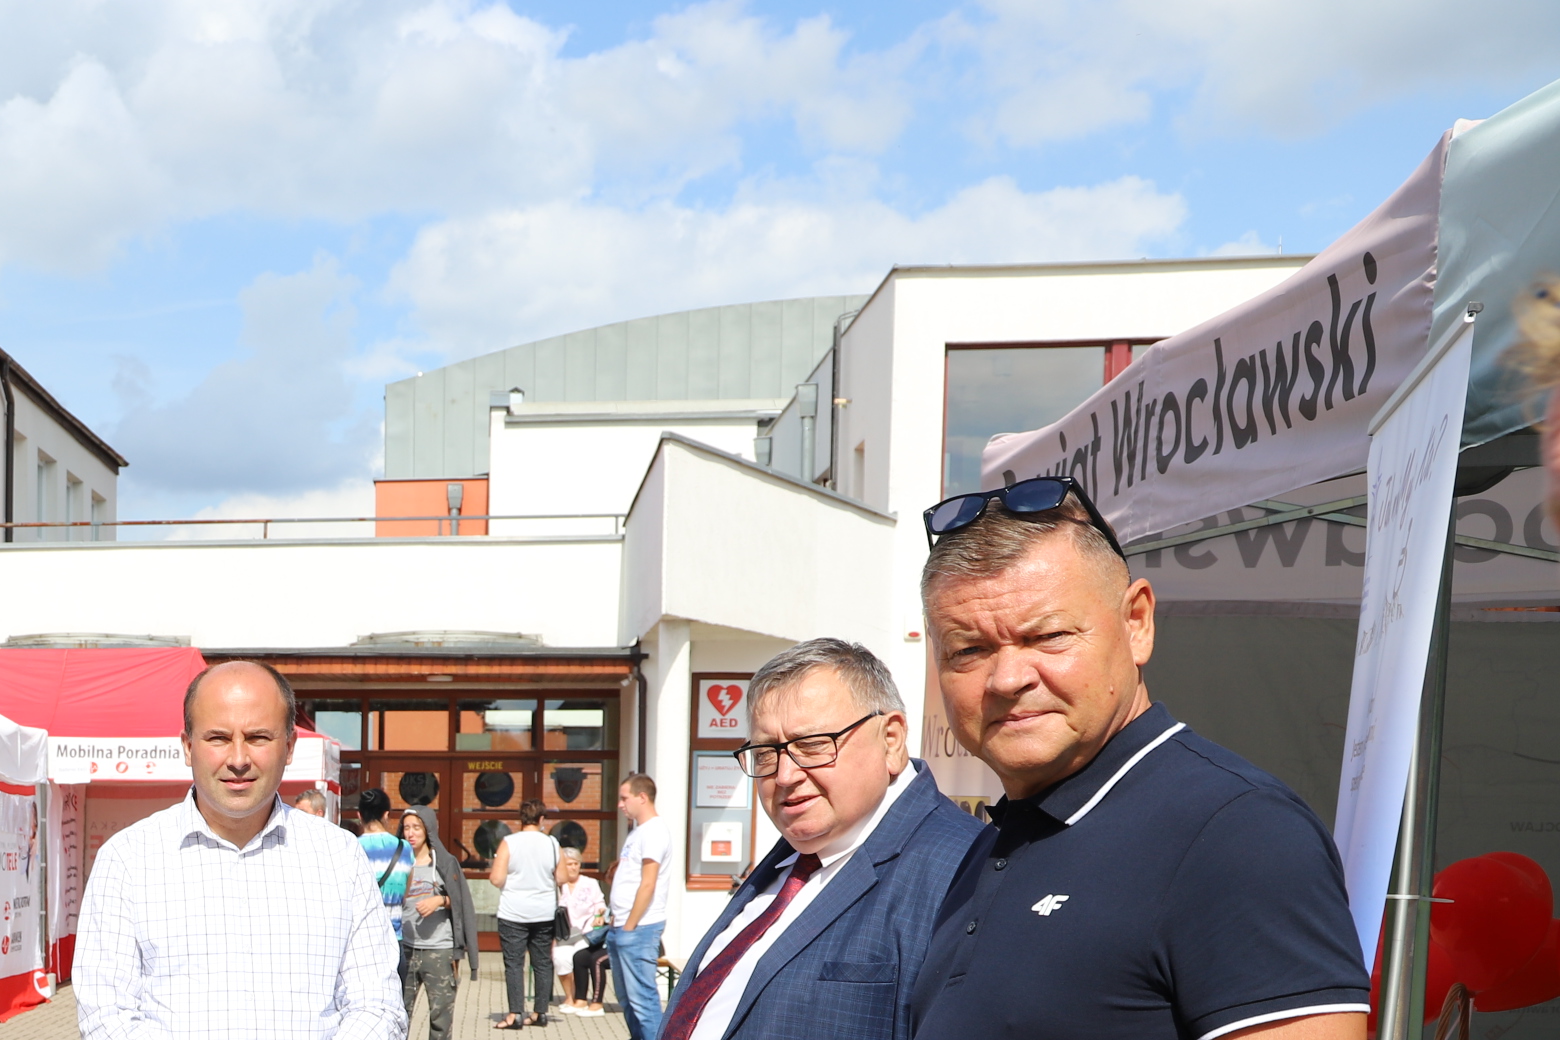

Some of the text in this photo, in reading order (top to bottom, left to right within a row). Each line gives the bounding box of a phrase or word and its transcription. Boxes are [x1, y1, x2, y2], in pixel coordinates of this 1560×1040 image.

[1111, 251, 1378, 497] Wrocławski
[709, 717, 739, 728] AED
[56, 744, 180, 760] Mobilna Poradnia
[467, 761, 504, 770] WEJŚCIE
[1031, 893, 1070, 917] 4F
